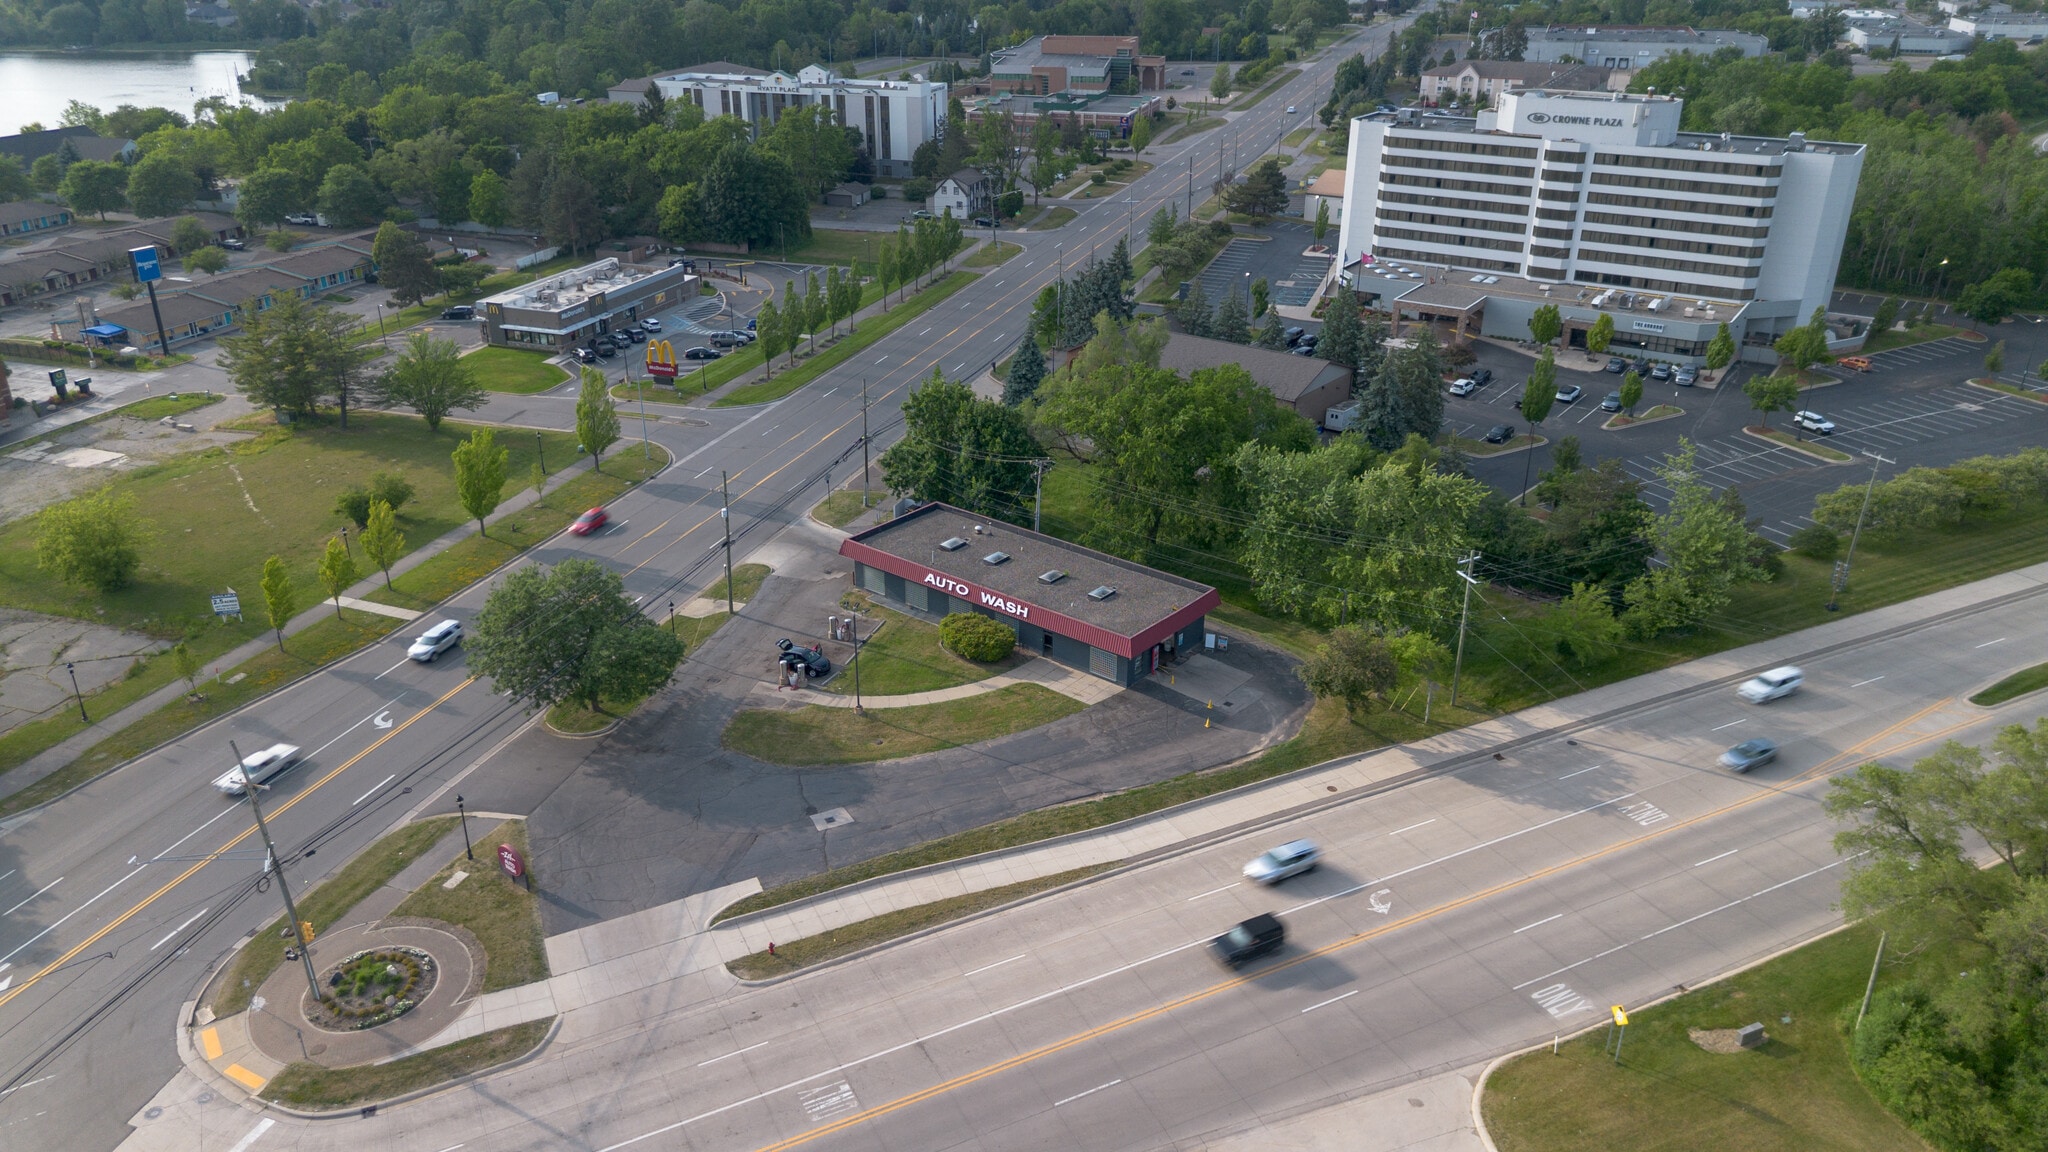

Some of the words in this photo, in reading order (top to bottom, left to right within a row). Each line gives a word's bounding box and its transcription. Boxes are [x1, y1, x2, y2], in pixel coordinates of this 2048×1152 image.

[1552, 114, 1591, 125] CROWNE
[1593, 117, 1623, 127] PLAZA
[924, 573, 969, 596] AUTO
[981, 591, 1029, 618] WASH
[1617, 801, 1669, 826] ONLY
[1531, 983, 1594, 1018] ONLY
[797, 1079, 858, 1122] ONLY
